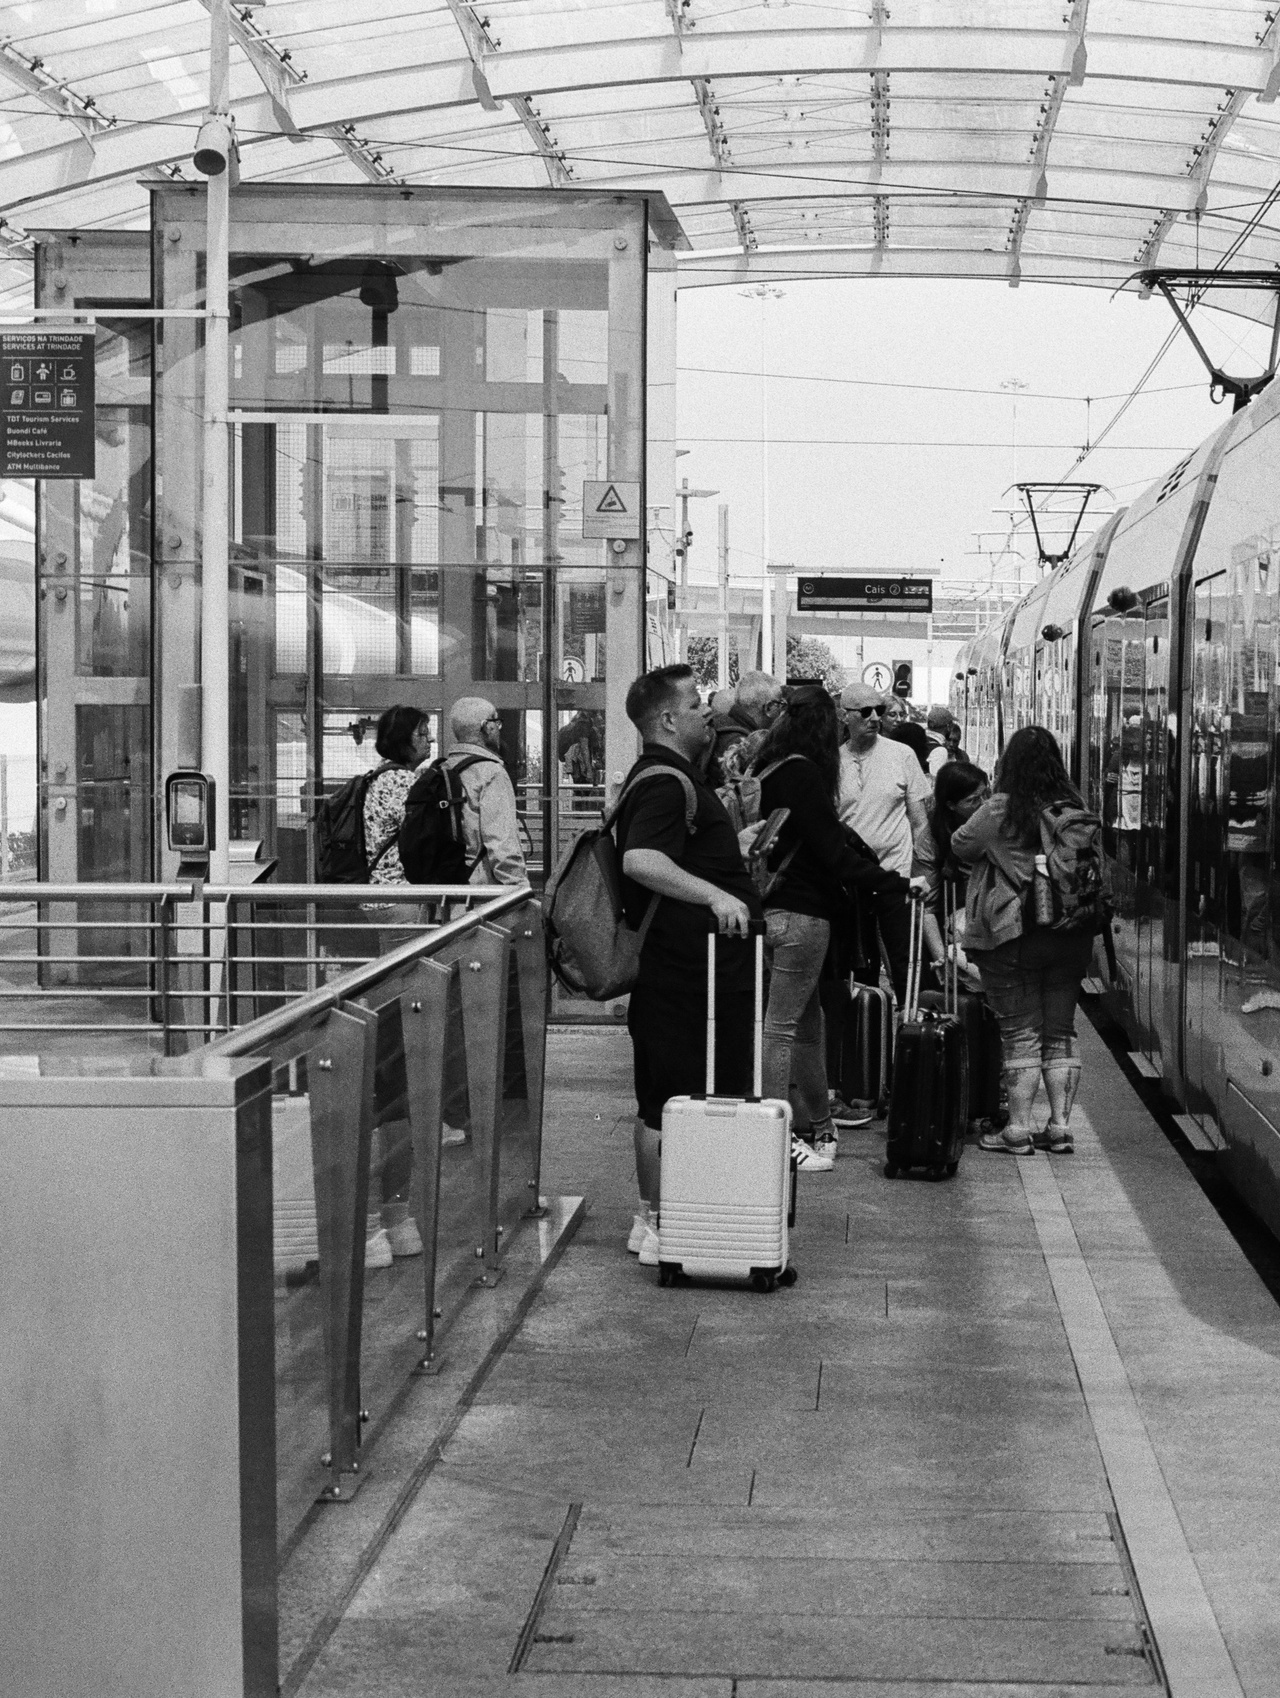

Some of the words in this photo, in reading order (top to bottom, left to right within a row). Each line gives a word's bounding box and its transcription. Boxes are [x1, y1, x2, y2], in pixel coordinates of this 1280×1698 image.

[2, 335, 36, 344] SERVIÇOS
[22, 415, 49, 423] Tourism
[50, 415, 80, 423] Services
[864, 584, 886, 594] Cais
